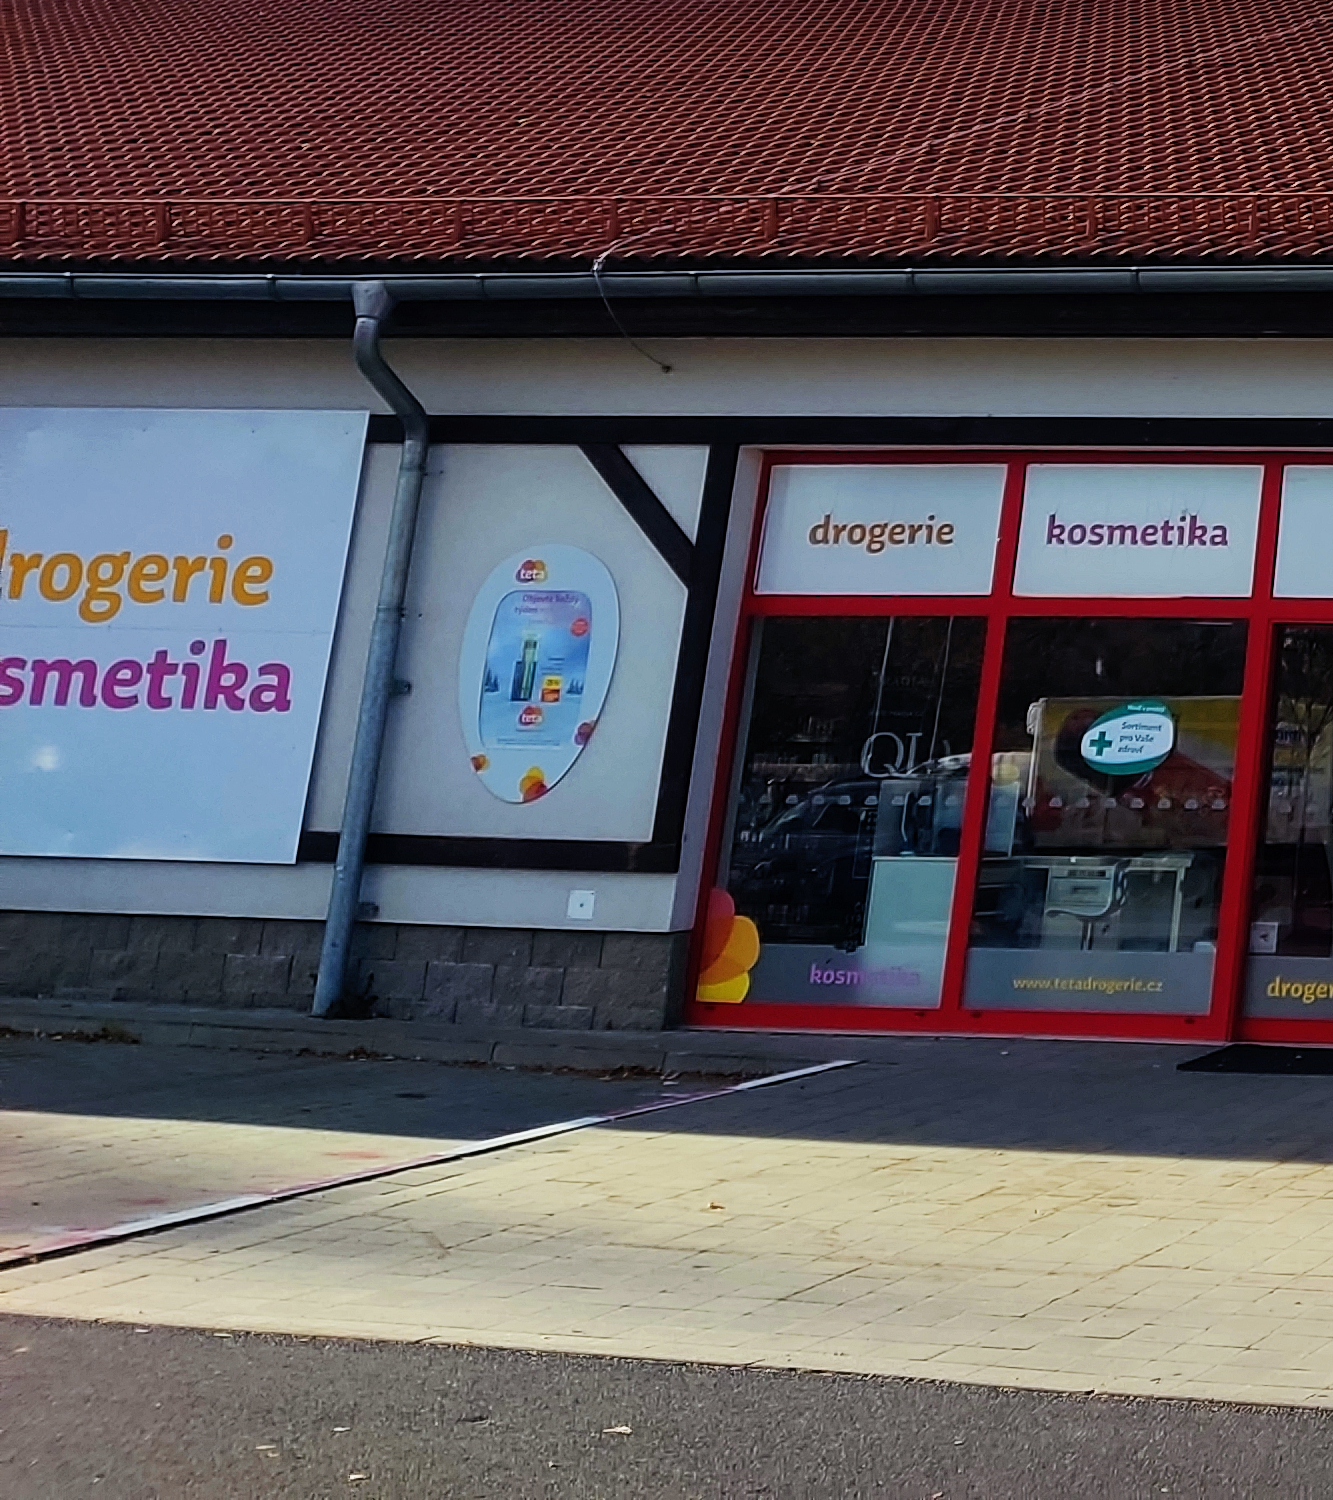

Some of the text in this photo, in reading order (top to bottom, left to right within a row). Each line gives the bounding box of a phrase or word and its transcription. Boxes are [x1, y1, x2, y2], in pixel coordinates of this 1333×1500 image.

[808, 513, 955, 554] drogerie
[1045, 512, 1229, 547] kosmetika
[520, 568, 545, 579] teta
[1012, 975, 1164, 994] www.tetadrogerie.cz
